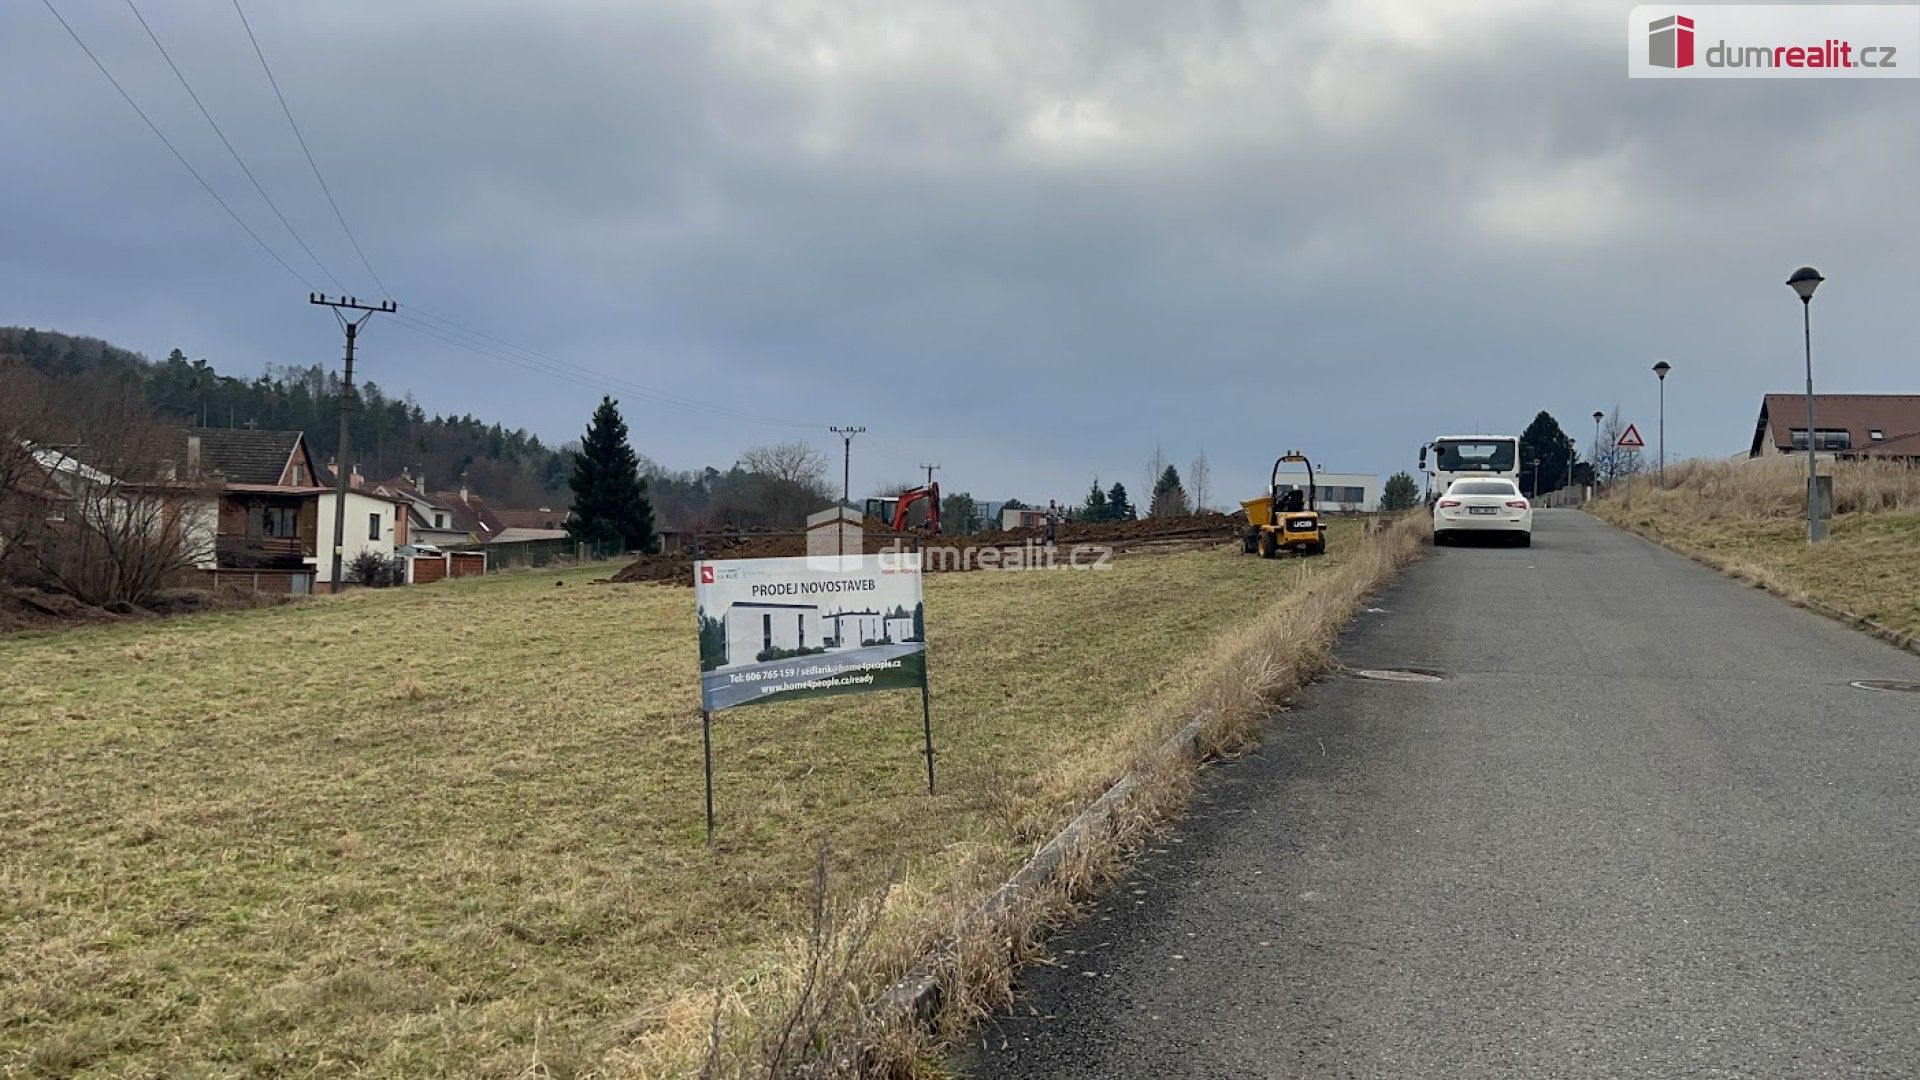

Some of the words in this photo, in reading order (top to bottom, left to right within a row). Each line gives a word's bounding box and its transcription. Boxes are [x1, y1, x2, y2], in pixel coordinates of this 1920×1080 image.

[752, 582, 799, 597] PRODEJ
[801, 579, 876, 594] NOVOSTAVEB
[745, 670, 761, 681] 606
